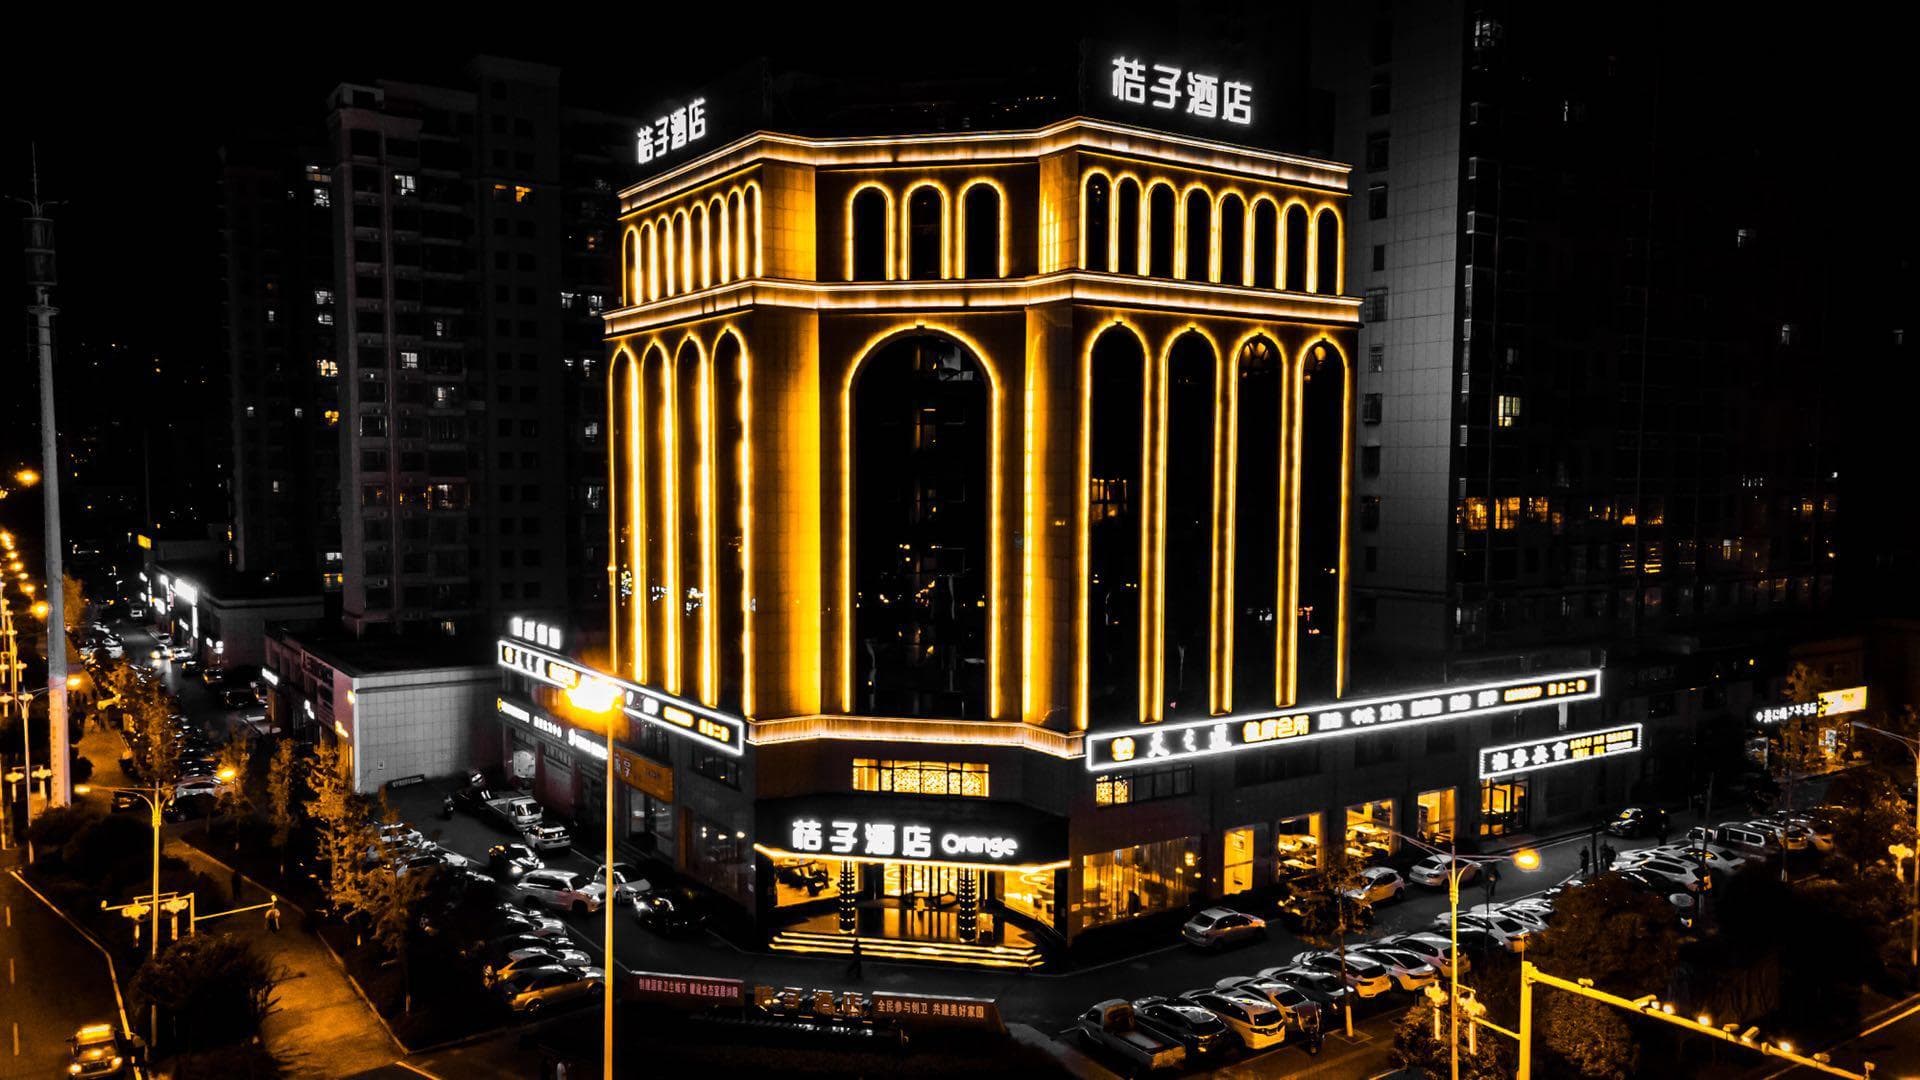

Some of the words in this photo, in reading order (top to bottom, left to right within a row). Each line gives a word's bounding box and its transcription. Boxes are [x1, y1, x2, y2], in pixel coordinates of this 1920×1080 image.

[1112, 56, 1252, 125] 桔子酒店
[636, 97, 706, 164] 桔子酒店
[791, 819, 932, 858] 桔子酒店
[940, 833, 1018, 858] Orange
[876, 999, 928, 1015] 全民参与创卫
[931, 1003, 985, 1019] 共建美好家园
